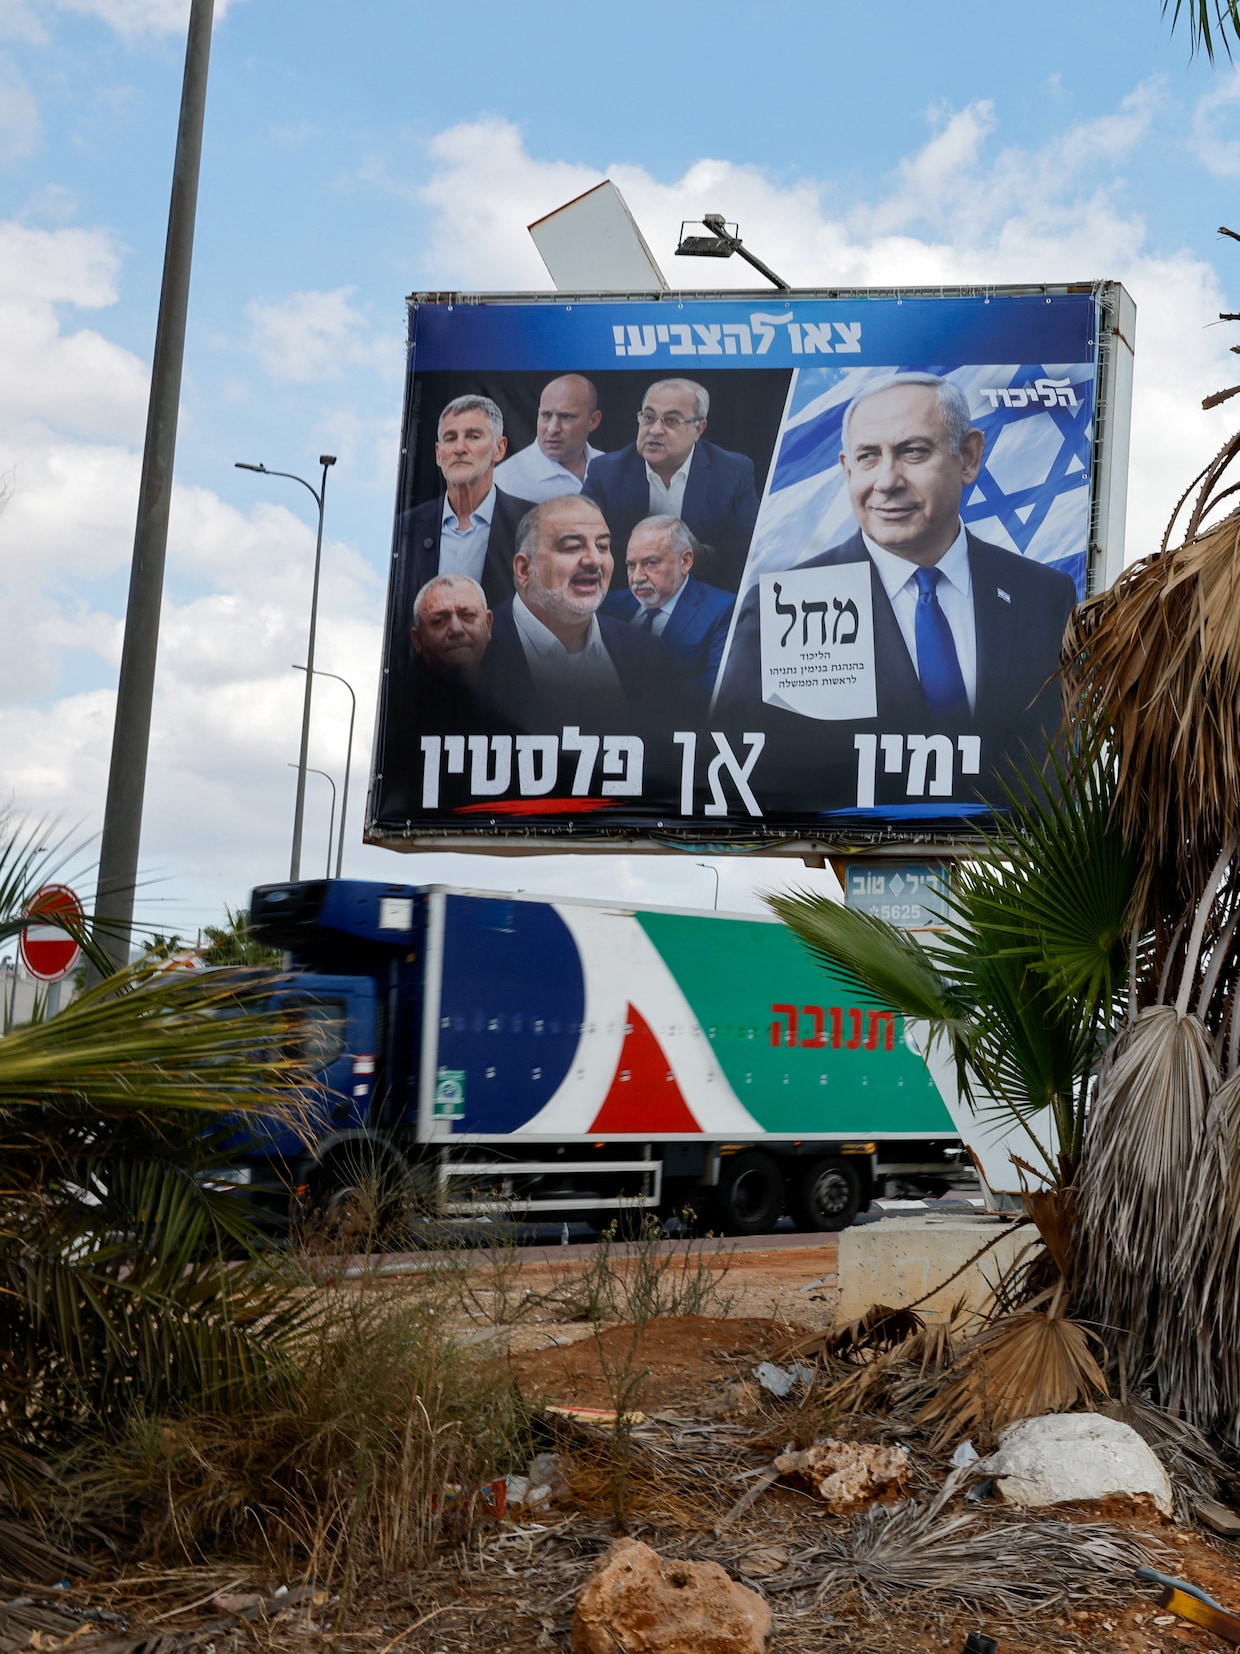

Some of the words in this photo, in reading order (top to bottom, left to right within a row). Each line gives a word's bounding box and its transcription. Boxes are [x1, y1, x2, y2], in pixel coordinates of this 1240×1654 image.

[612, 311, 793, 356] להצביע!
[788, 322, 862, 354] צאו
[980, 377, 1078, 408] הליכוד
[773, 582, 859, 648] מחל
[769, 666, 797, 676] נתניהו
[800, 650, 831, 661] הליכוד
[800, 665, 828, 675] בנימין
[830, 662, 865, 672] בהנהגת
[778, 677, 819, 688] הממשלה
[821, 675, 857, 687] לראשות
[421, 726, 645, 809] פלסטין
[673, 731, 766, 817] או
[854, 734, 981, 808] ימין
[769, 1003, 895, 1051] תנובה
